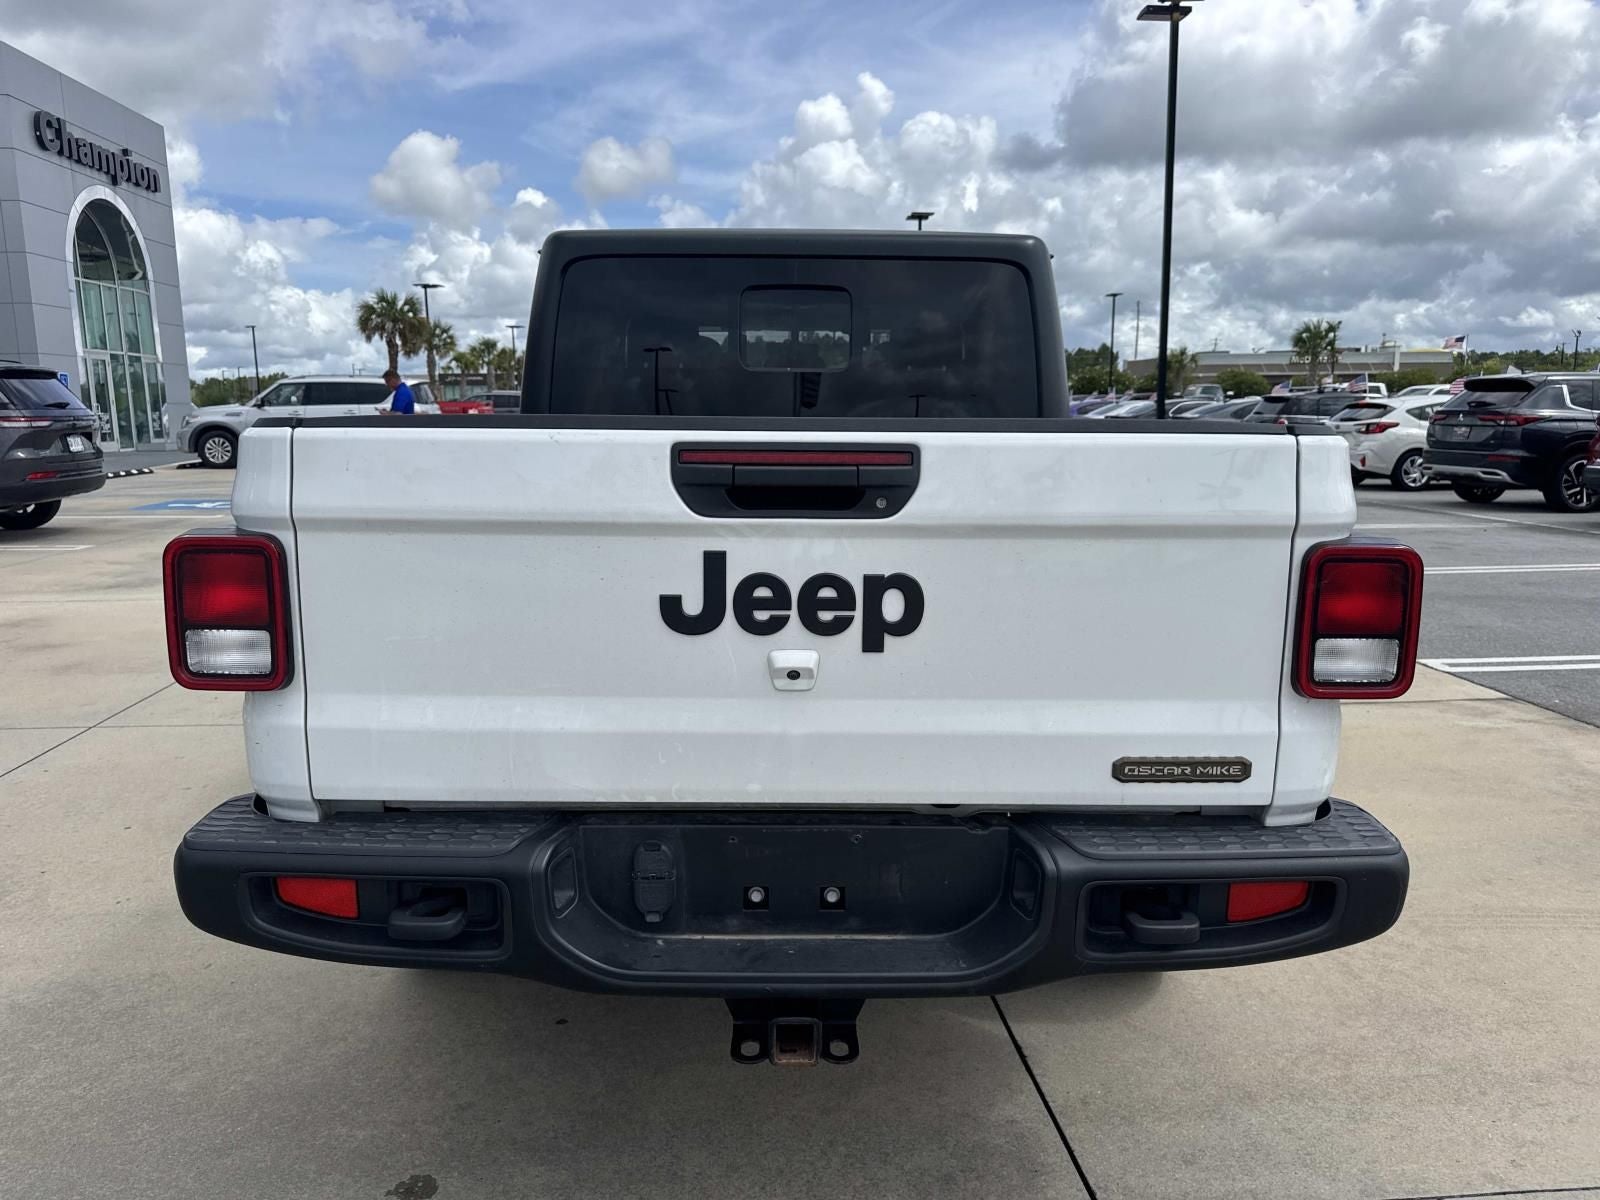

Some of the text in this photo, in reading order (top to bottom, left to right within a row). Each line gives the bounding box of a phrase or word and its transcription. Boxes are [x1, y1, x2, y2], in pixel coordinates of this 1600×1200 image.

[34, 110, 161, 193] Champion
[659, 550, 925, 653] Jeep
[1124, 765, 1242, 776] OSCAR MIKE
